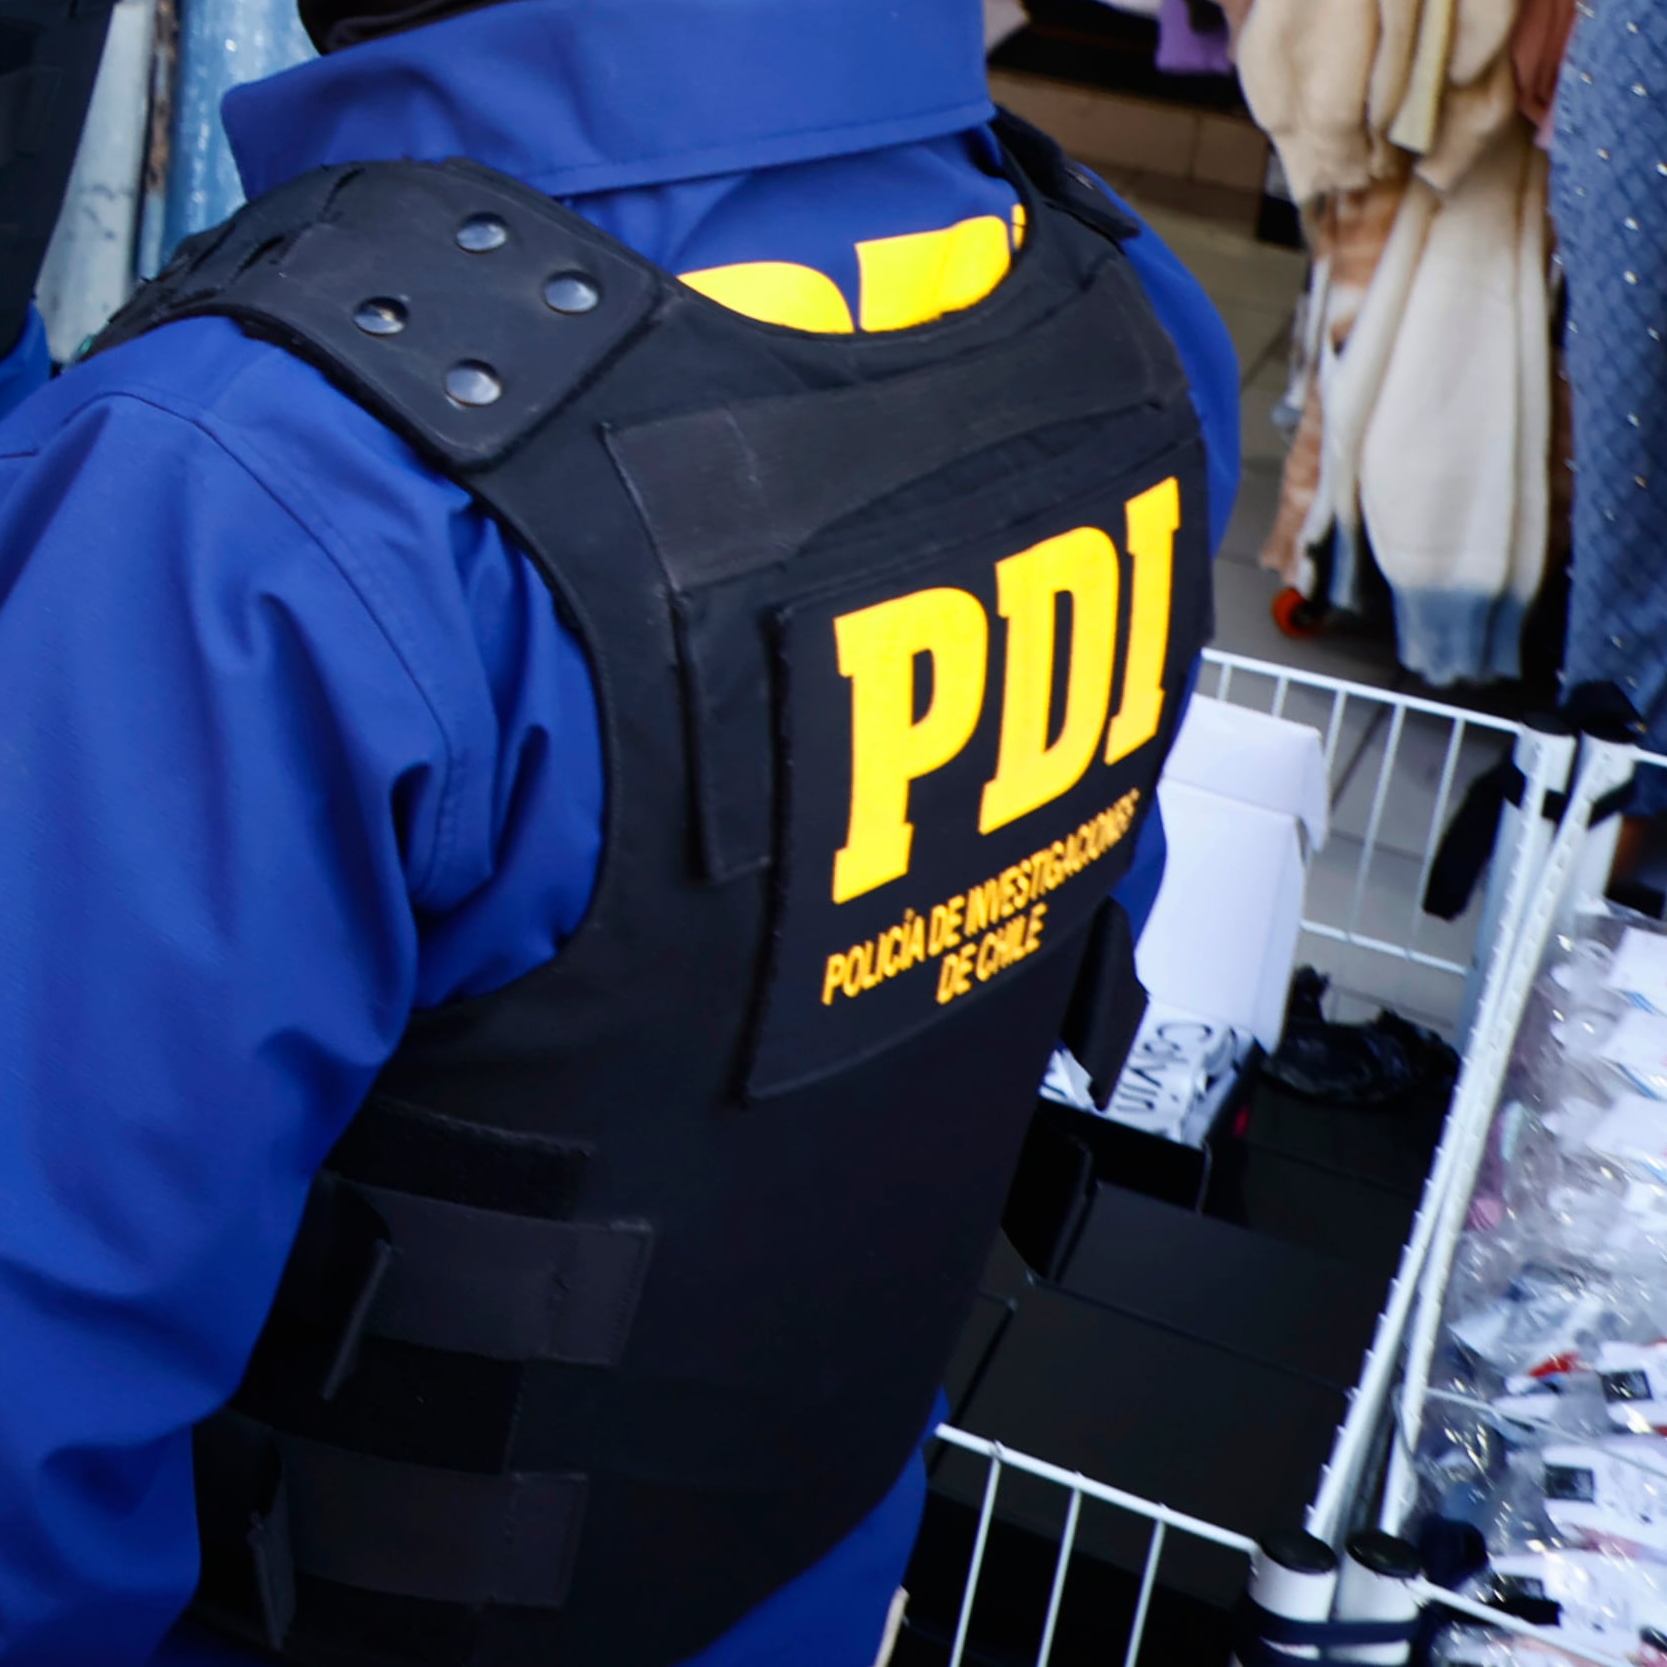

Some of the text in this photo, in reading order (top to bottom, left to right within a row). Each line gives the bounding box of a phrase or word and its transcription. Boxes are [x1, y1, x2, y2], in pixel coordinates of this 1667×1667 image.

[831, 476, 1182, 906] PDI
[926, 894, 967, 957] DE
[936, 901, 1048, 1005] DE CHILE
